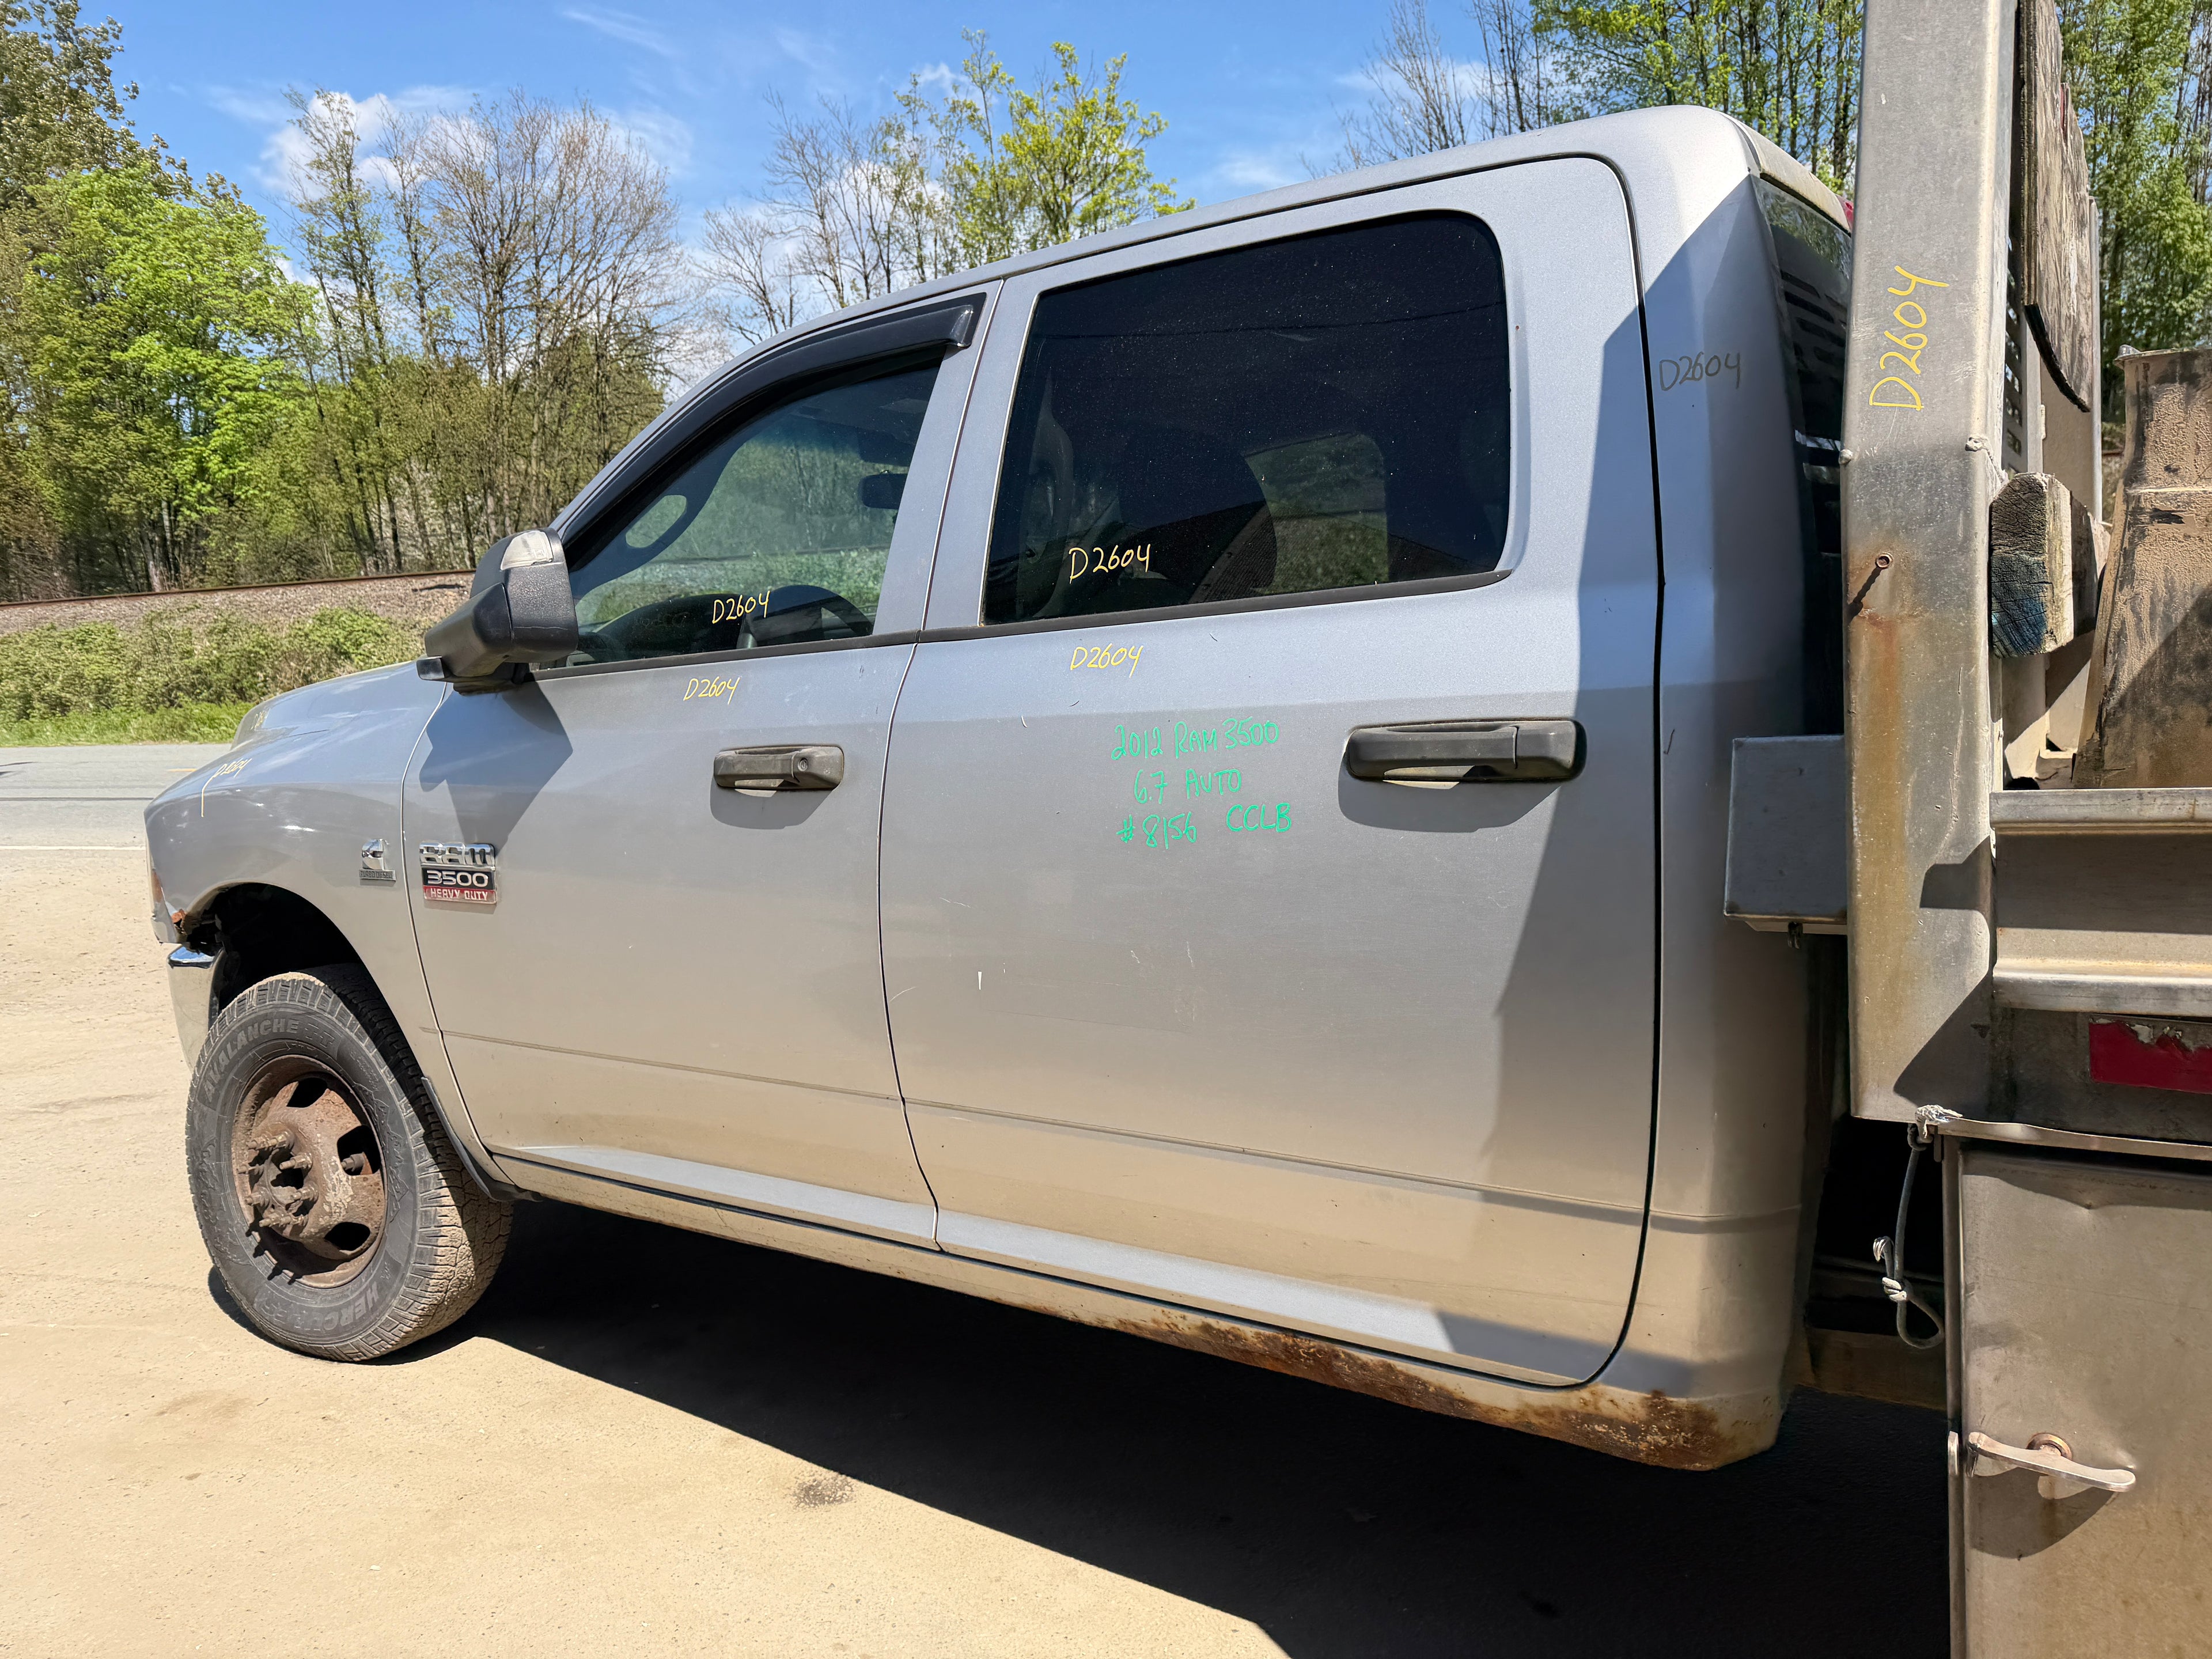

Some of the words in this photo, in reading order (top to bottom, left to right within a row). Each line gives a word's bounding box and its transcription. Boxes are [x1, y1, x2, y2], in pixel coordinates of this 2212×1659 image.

[1869, 265, 1950, 411] D2604
[1659, 351, 1741, 391] D2604
[1069, 544, 1151, 584] D2604
[712, 590, 771, 624] D2604
[1070, 643, 1143, 678] D2604
[683, 676, 741, 705] D2604
[1111, 724, 1163, 760] 2012
[1174, 721, 1218, 759] RAM
[1222, 715, 1279, 749] 3500
[1185, 768, 1242, 800] AUTO
[1116, 811, 1198, 850] #8156
[1226, 802, 1292, 833] CCLB
[419, 842, 495, 866] RAM
[427, 869, 488, 887] 3500
[464, 891, 488, 901] DUTY
